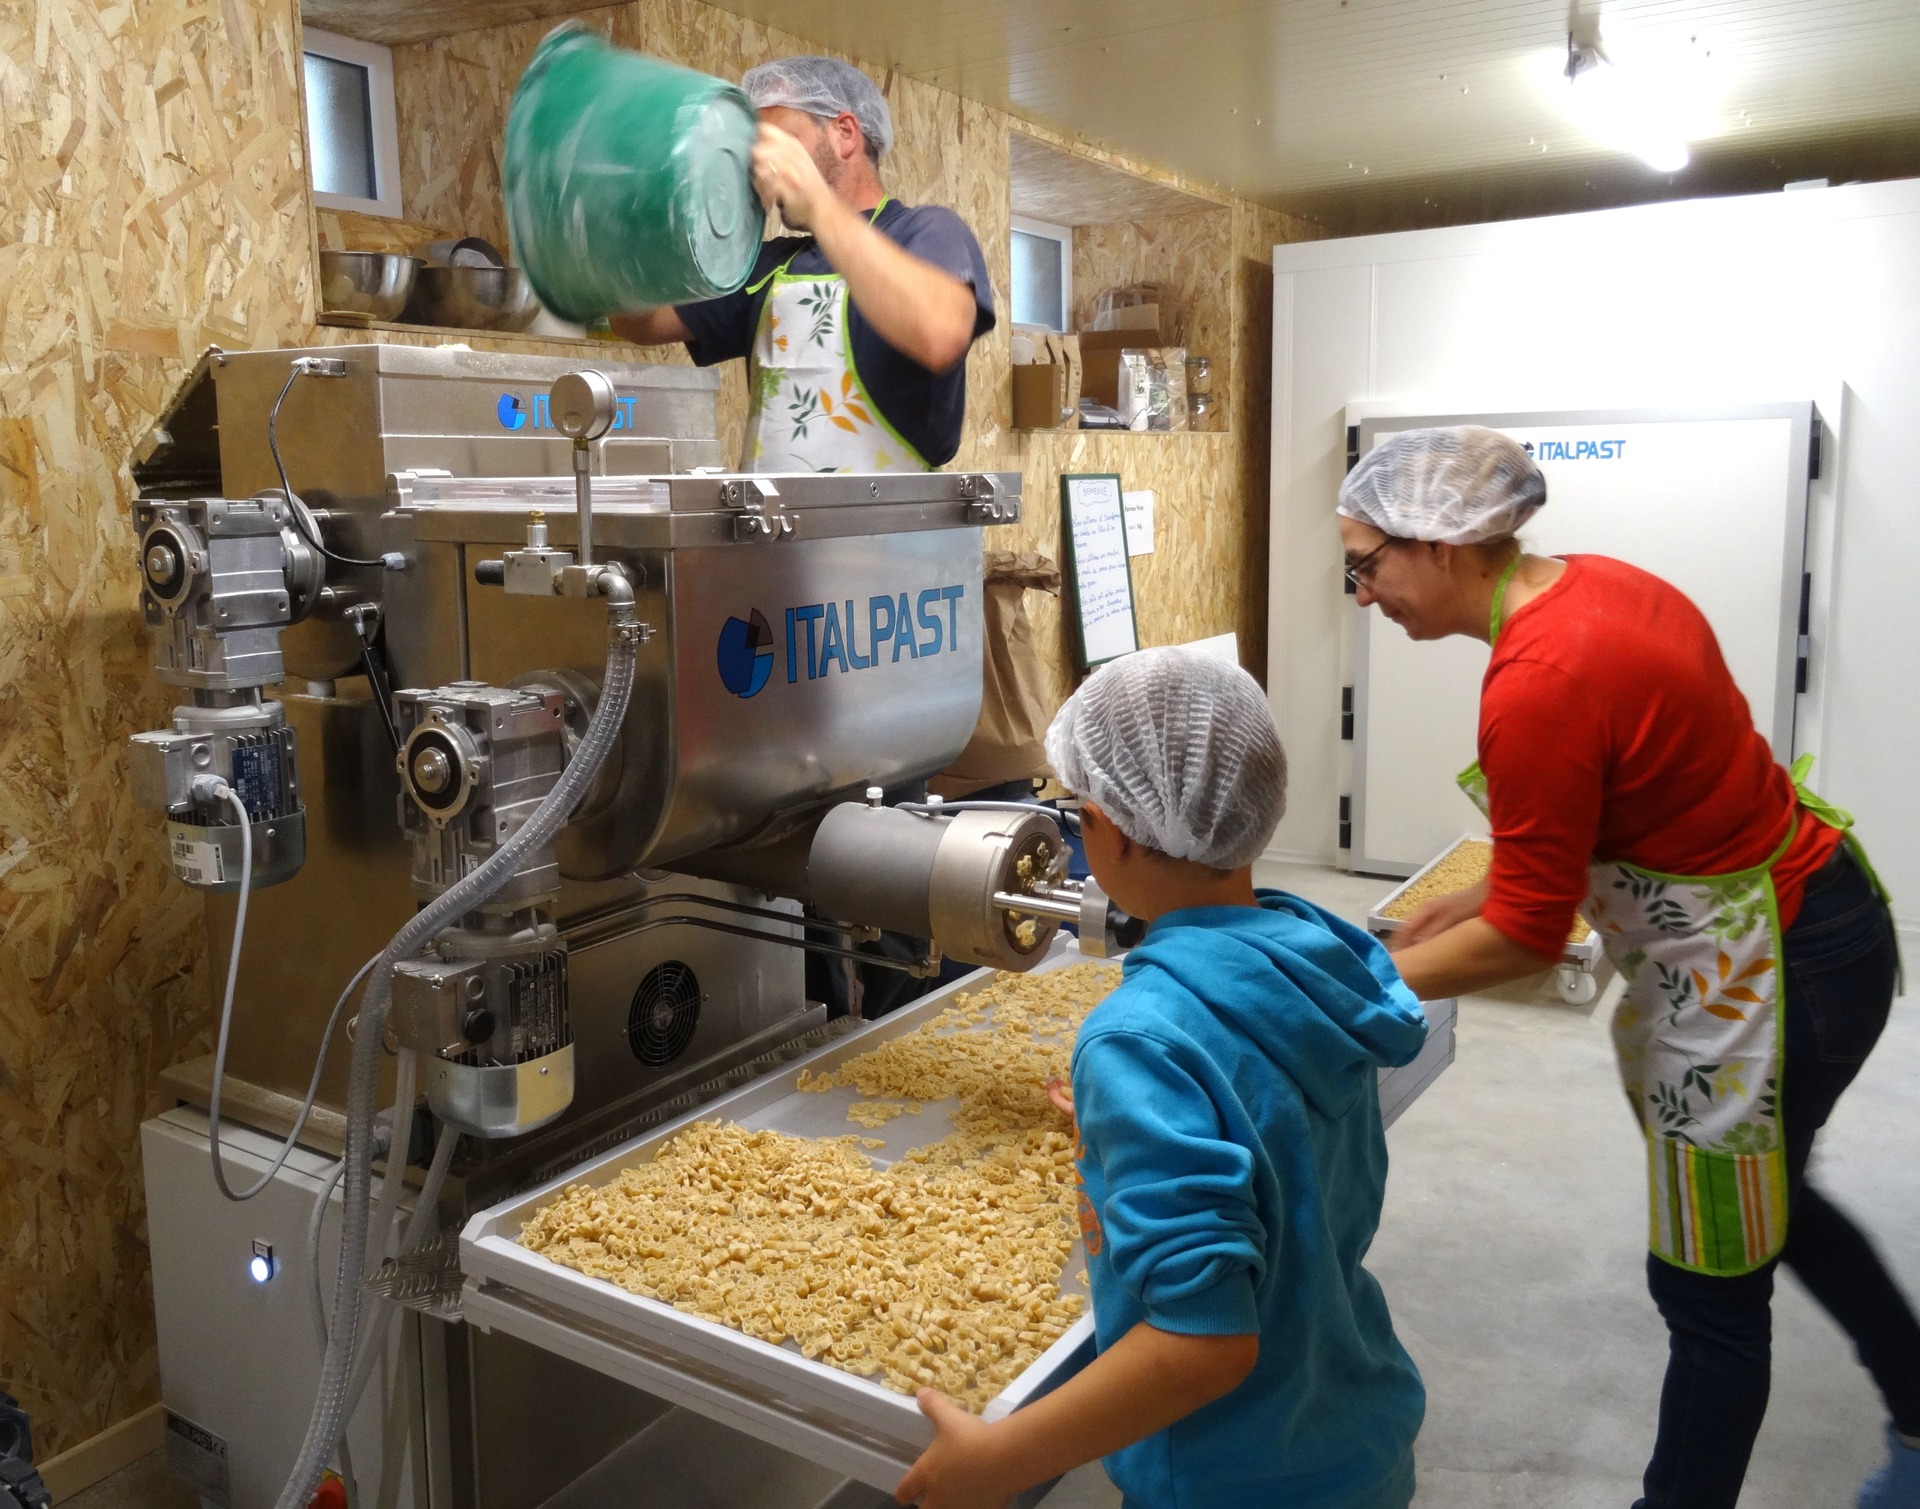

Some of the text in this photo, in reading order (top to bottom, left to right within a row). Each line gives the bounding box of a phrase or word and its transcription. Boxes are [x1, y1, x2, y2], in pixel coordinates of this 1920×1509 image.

[532, 393, 638, 430] ITST
[1538, 440, 1626, 460] ITALPAST
[785, 584, 964, 684] ITALPAST
